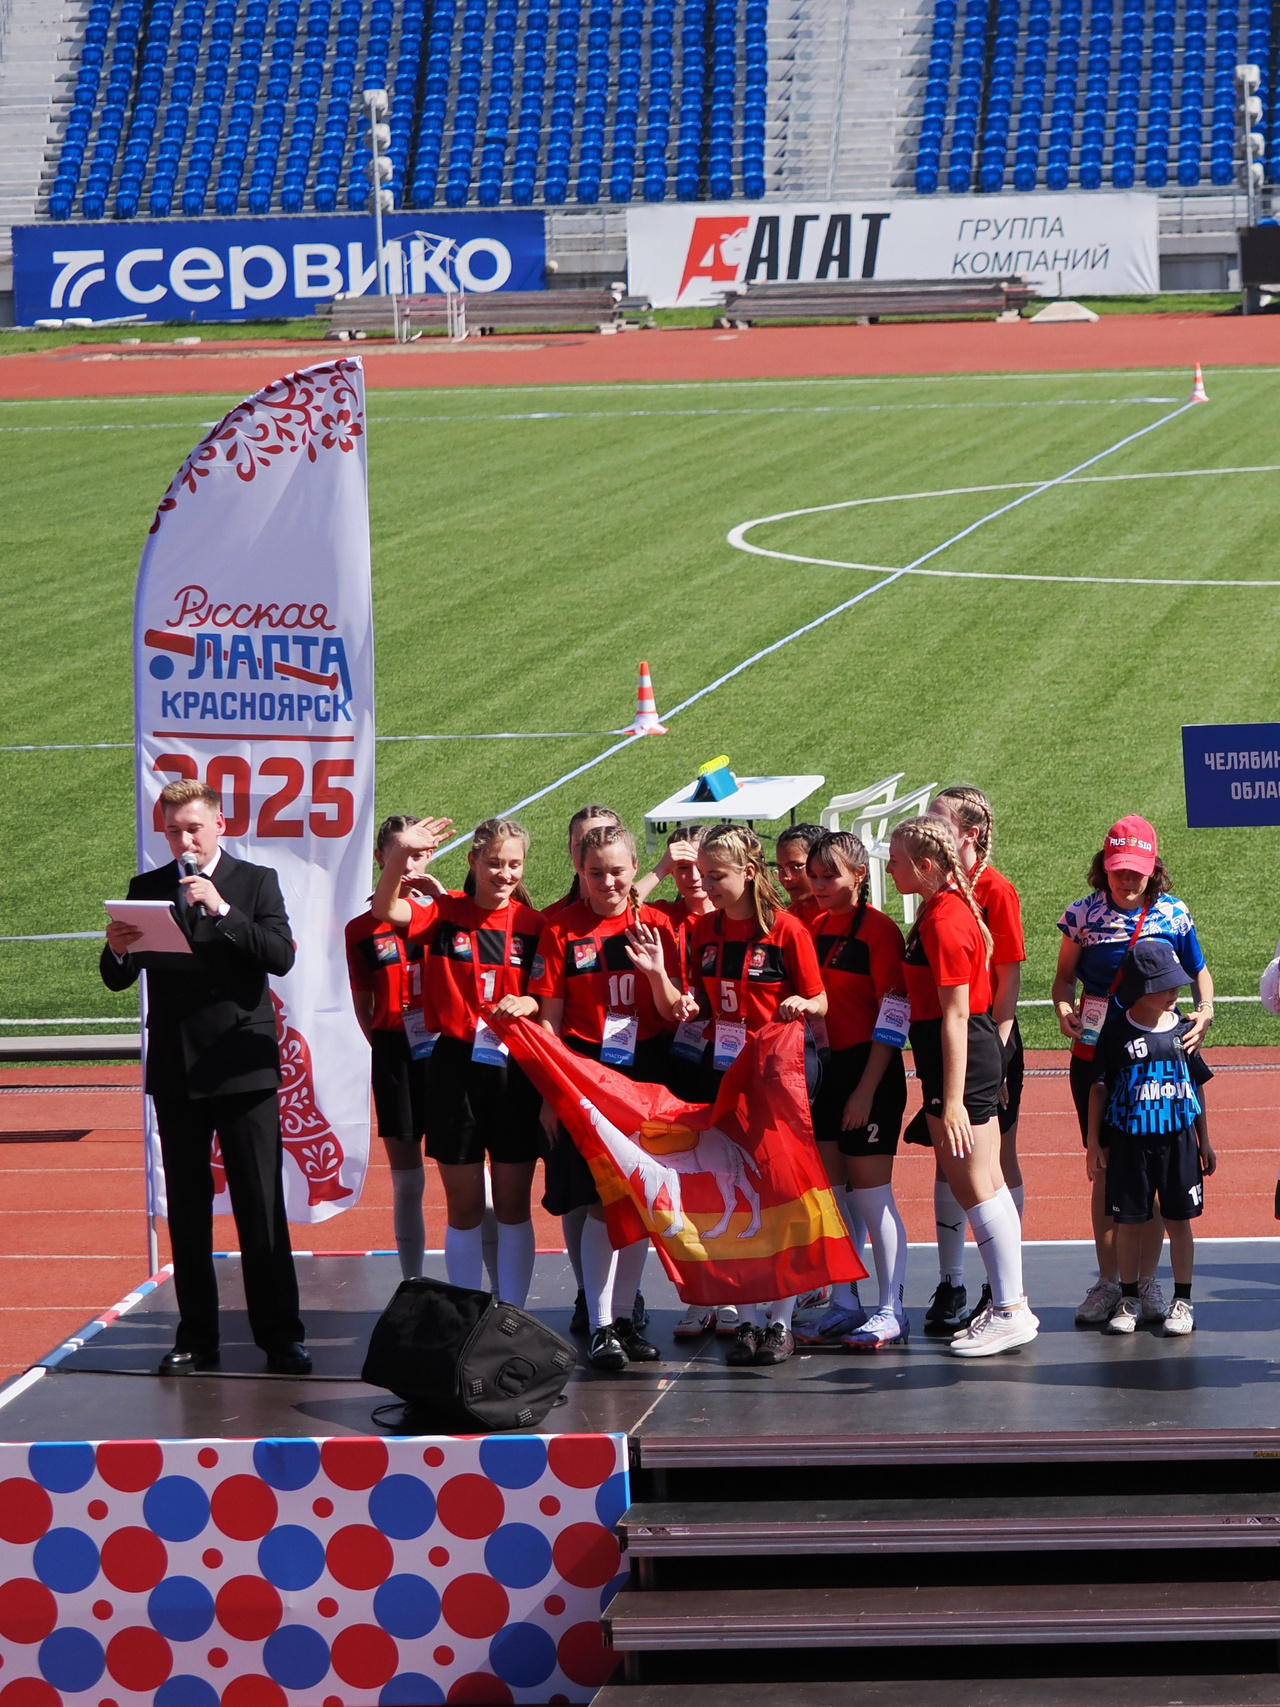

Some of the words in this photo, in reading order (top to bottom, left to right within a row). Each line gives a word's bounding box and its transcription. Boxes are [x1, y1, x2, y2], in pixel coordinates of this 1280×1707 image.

[957, 216, 1066, 242] ГРУППА
[746, 213, 891, 280] АГАТ
[952, 243, 1111, 275] КОМПАНИЙ
[165, 584, 337, 631] Русская
[188, 632, 353, 700] ЛАПТА
[161, 691, 353, 723] КРАСНОЯРСК
[1137, 840, 1152, 852] SIA
[480, 969, 497, 1002] 1
[608, 973, 635, 1007] 10
[720, 980, 738, 1013] 5
[1124, 1037, 1149, 1060] 15
[867, 1123, 879, 1143] 2
